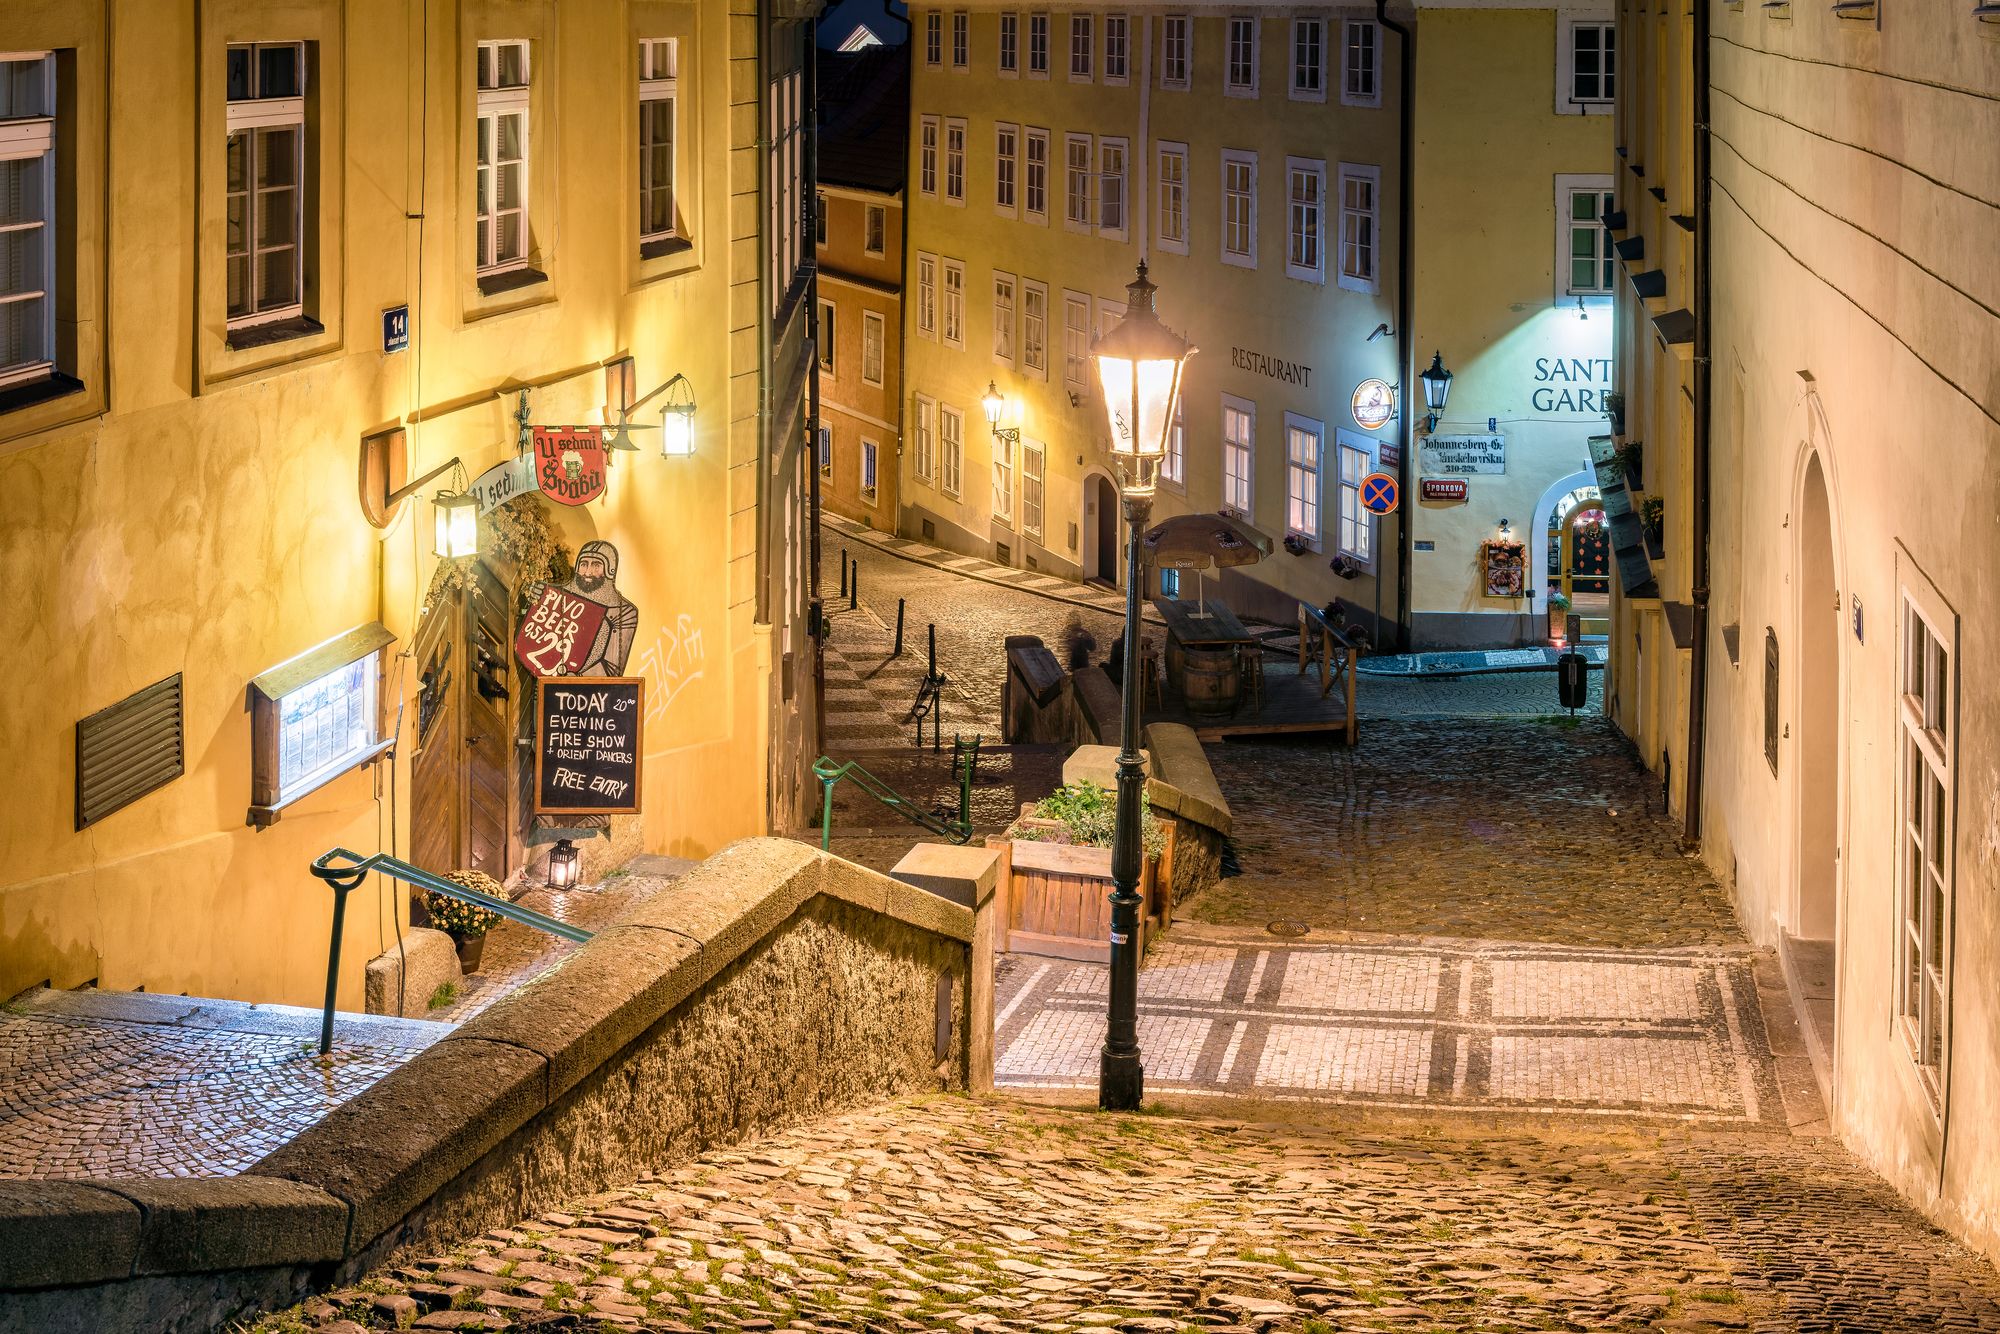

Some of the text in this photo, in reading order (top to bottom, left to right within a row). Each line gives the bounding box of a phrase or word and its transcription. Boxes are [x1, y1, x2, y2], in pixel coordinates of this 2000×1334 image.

[392, 315, 404, 335] 14
[1232, 346, 1312, 388] RESTAURANT
[536, 435, 597, 458] U sedmi
[1426, 482, 1464, 492] ŠPORKOVA
[543, 589, 585, 620] PIVO
[531, 604, 579, 644] BEER
[555, 692, 609, 714] TODAY
[550, 714, 617, 731] EVENING
[549, 732, 626, 749] FIRE SHOW
[557, 749, 592, 760] ORIENT
[596, 750, 633, 764] DANCERS
[552, 767, 629, 800] FREE ENTRY
